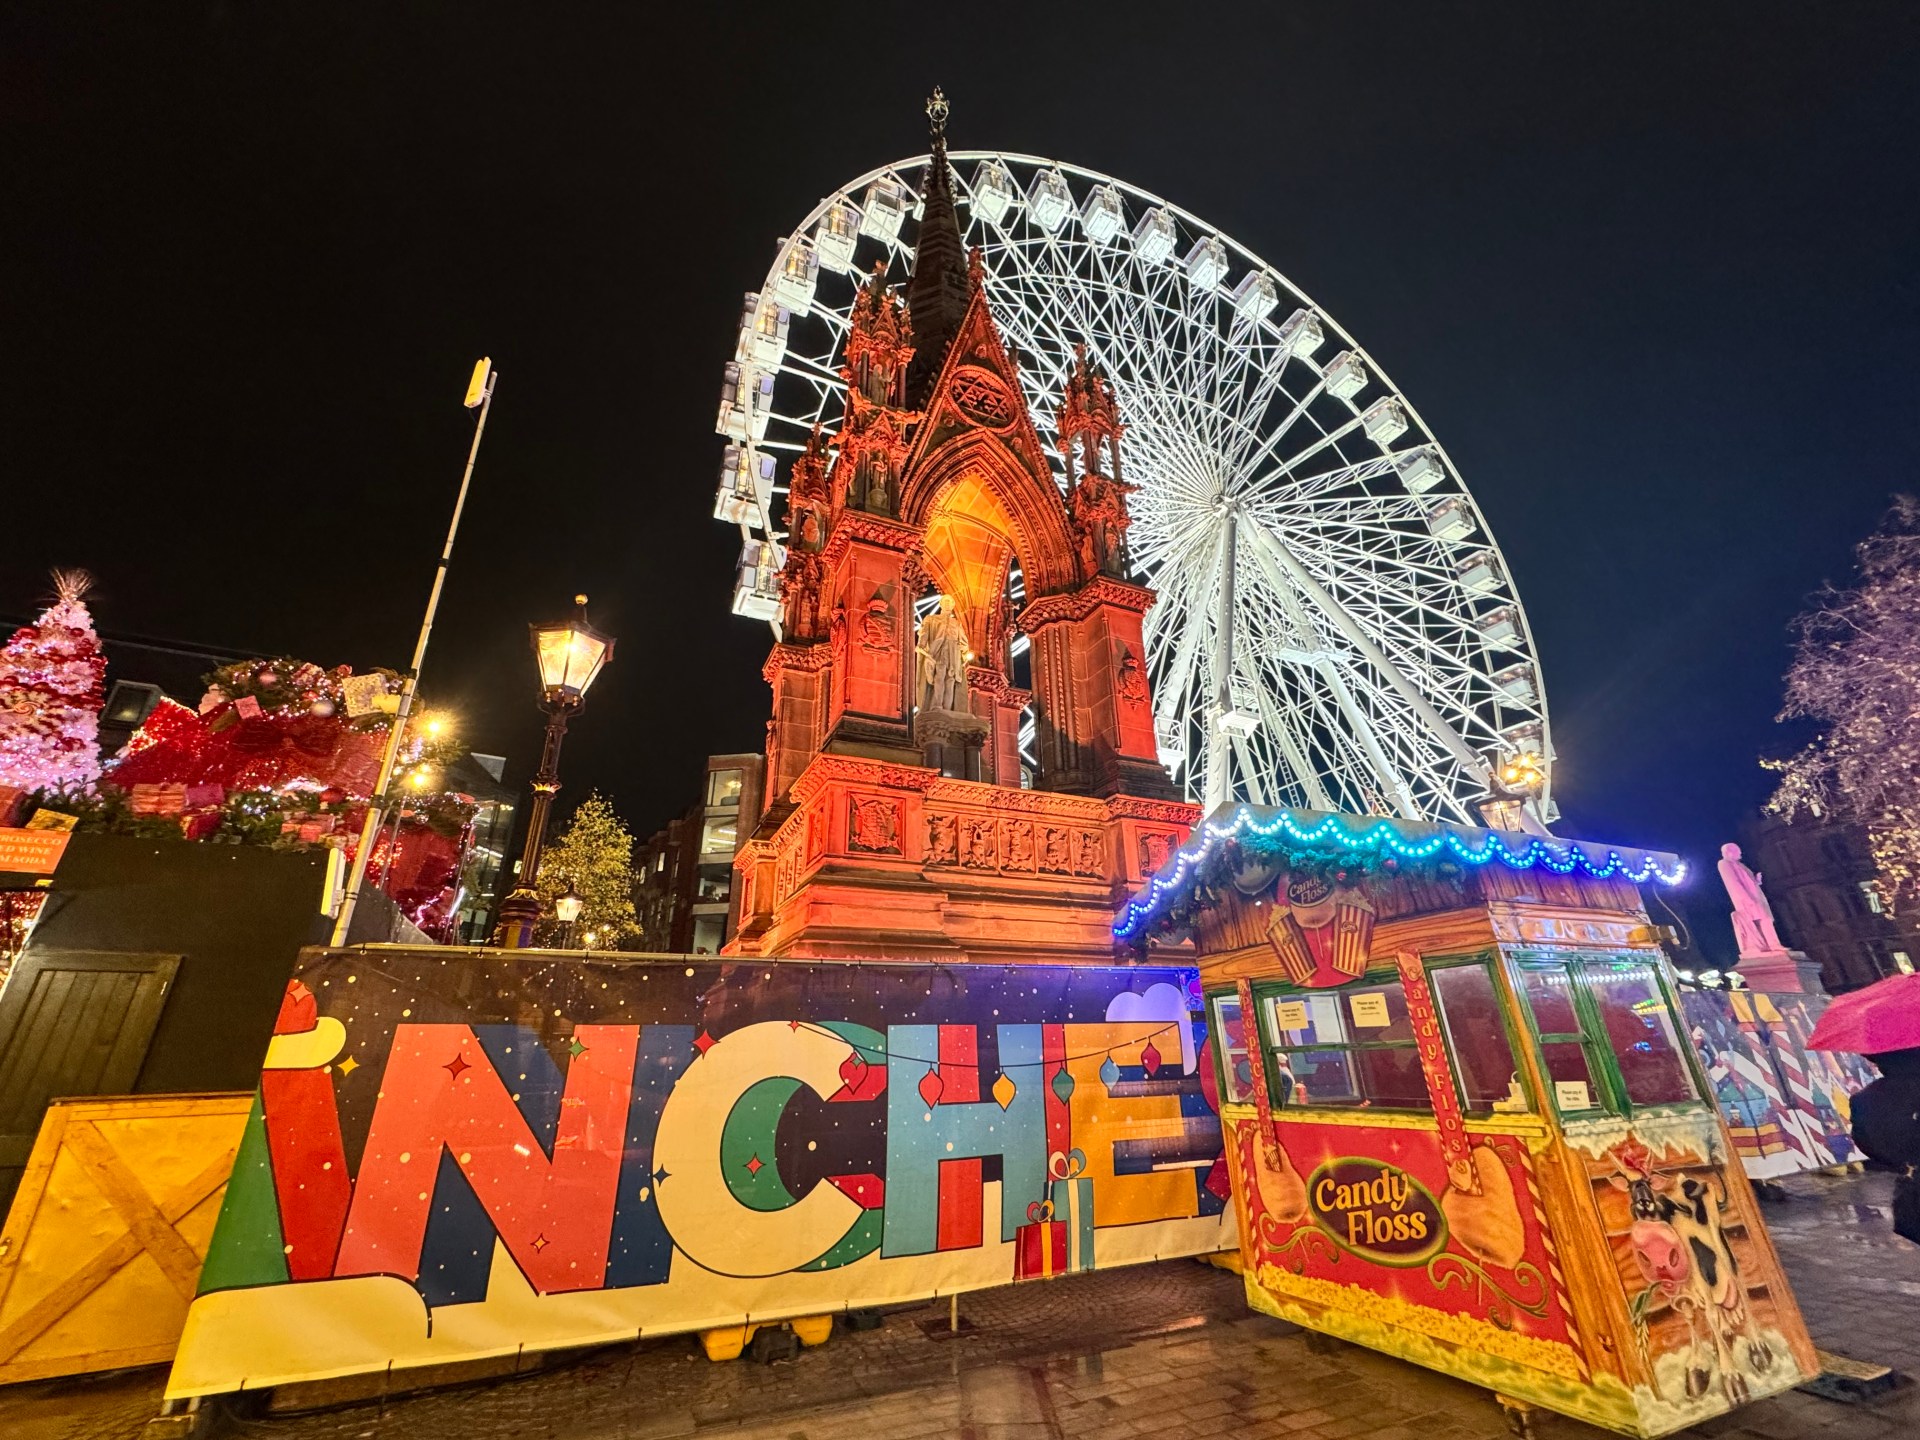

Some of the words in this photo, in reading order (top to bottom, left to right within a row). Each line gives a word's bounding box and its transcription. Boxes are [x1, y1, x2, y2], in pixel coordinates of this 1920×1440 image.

[0, 835, 62, 846] ROSECCO
[19, 846, 53, 855] WINE
[12, 855, 47, 865] SODA
[1300, 883, 1329, 905] Floss
[1406, 965, 1438, 1061] Candy
[1316, 1168, 1408, 1212] Candy
[1347, 1209, 1427, 1246] Floss
